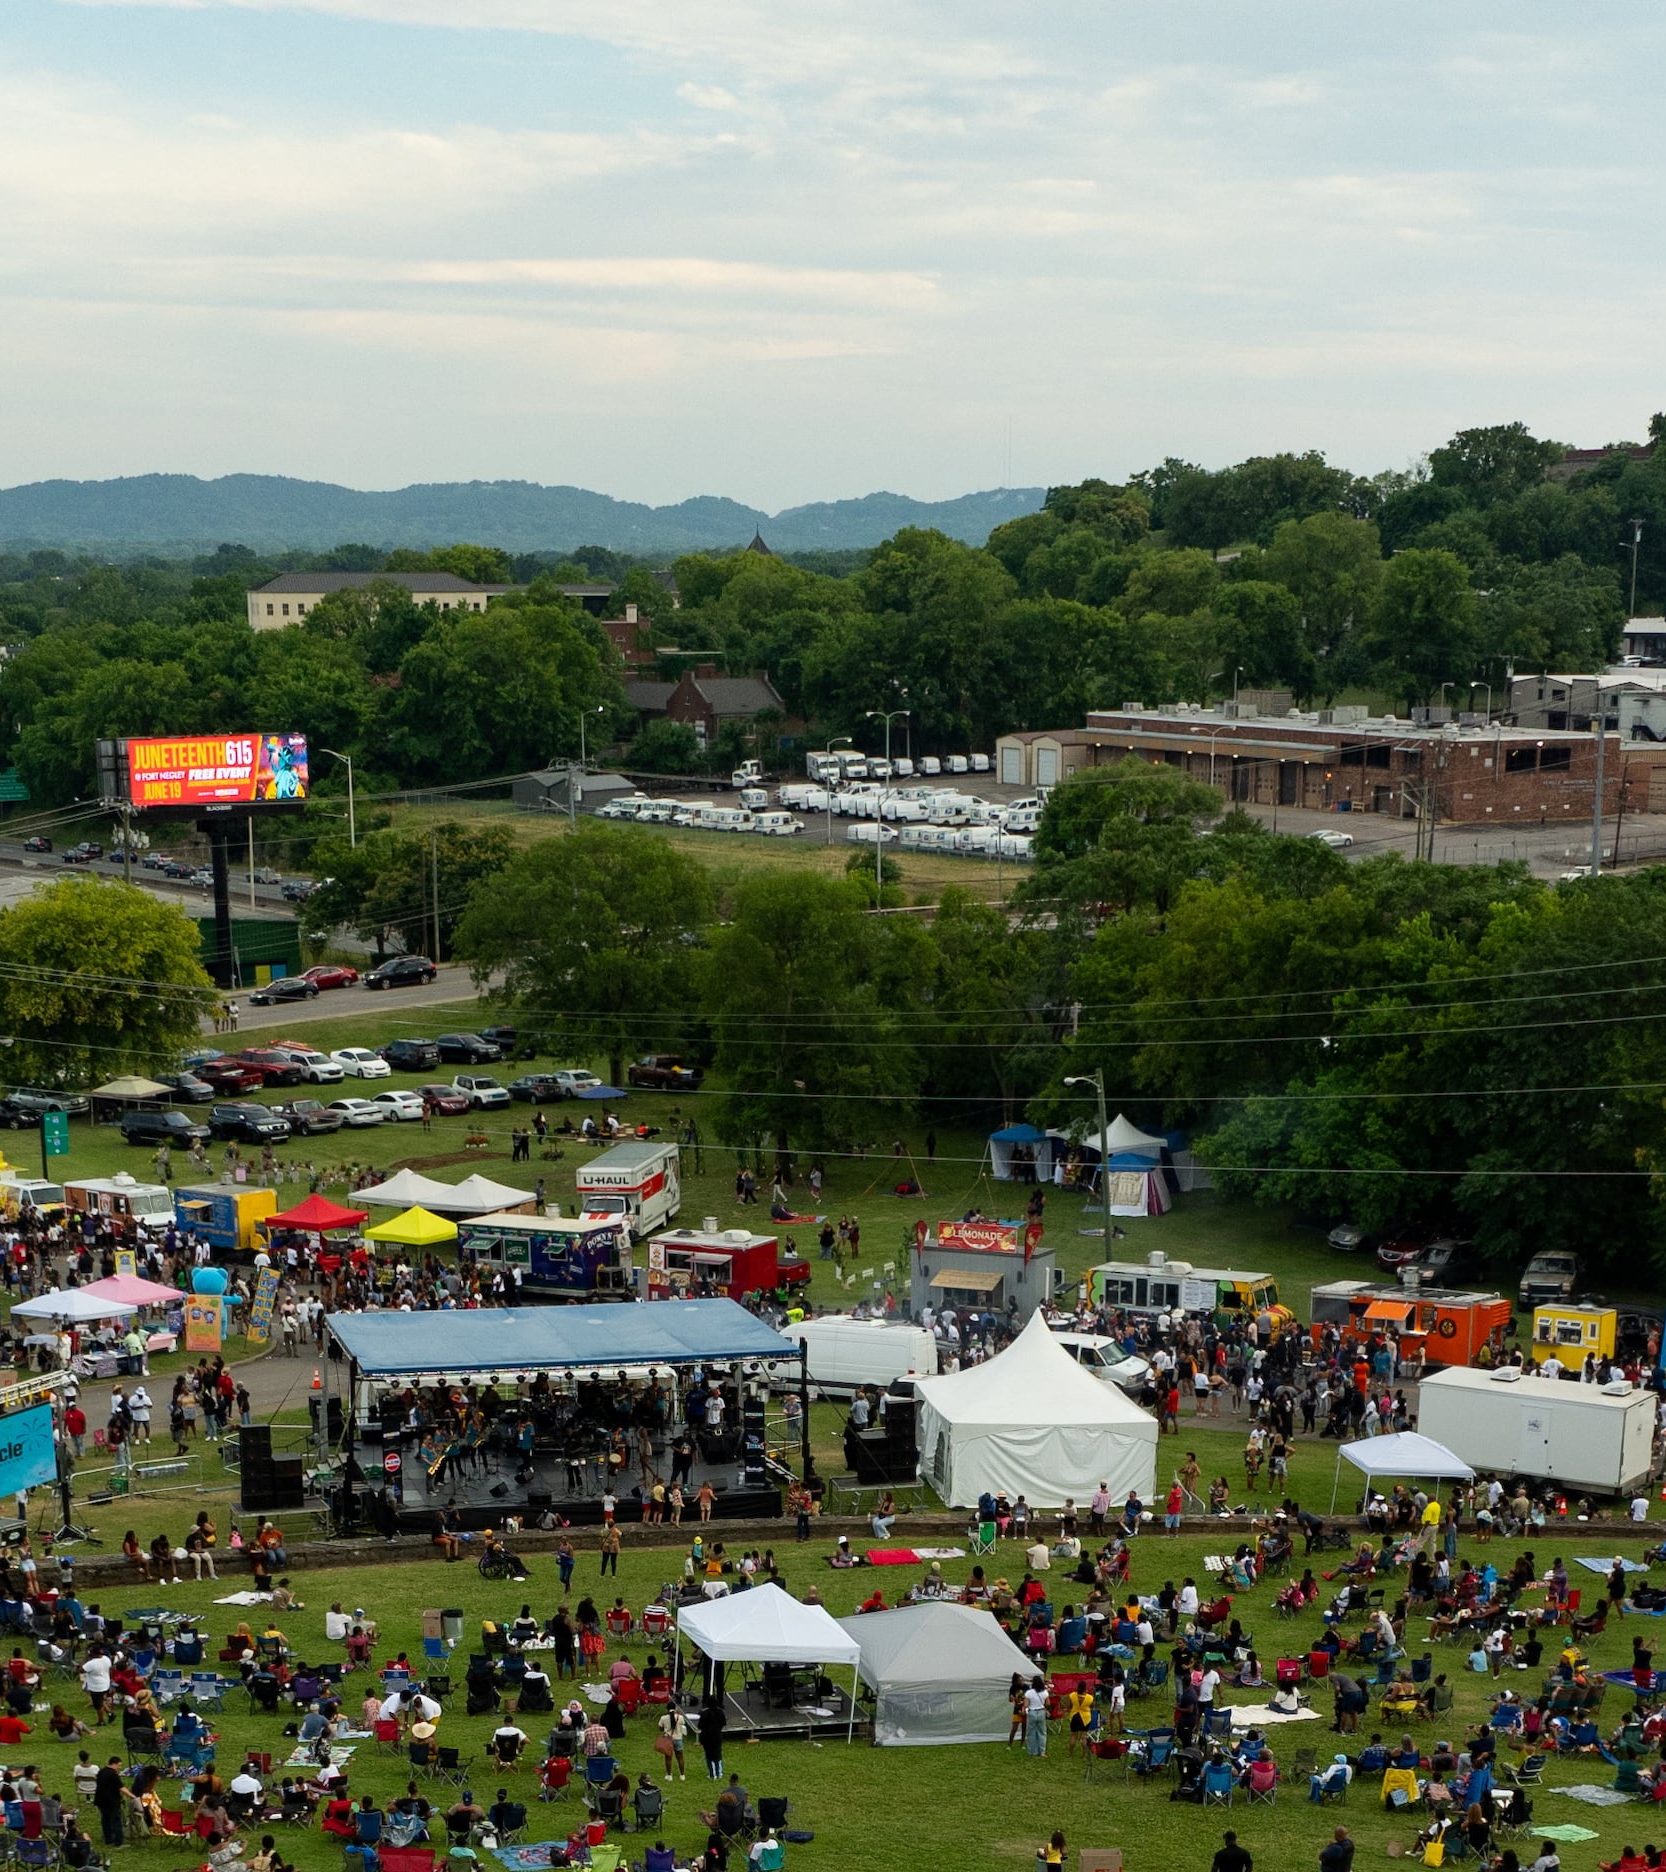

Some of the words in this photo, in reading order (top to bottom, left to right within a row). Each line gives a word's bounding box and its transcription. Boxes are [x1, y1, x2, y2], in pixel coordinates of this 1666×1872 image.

[134, 740, 253, 770] JUNETEENTH615
[142, 772, 159, 781] FORT
[188, 768, 216, 780] FREE
[216, 766, 251, 780] EVENT
[144, 782, 169, 800] JUNE
[169, 781, 182, 799] 19
[583, 1176, 630, 1185] U-HAUL
[952, 1228, 1004, 1241] LEMONADE
